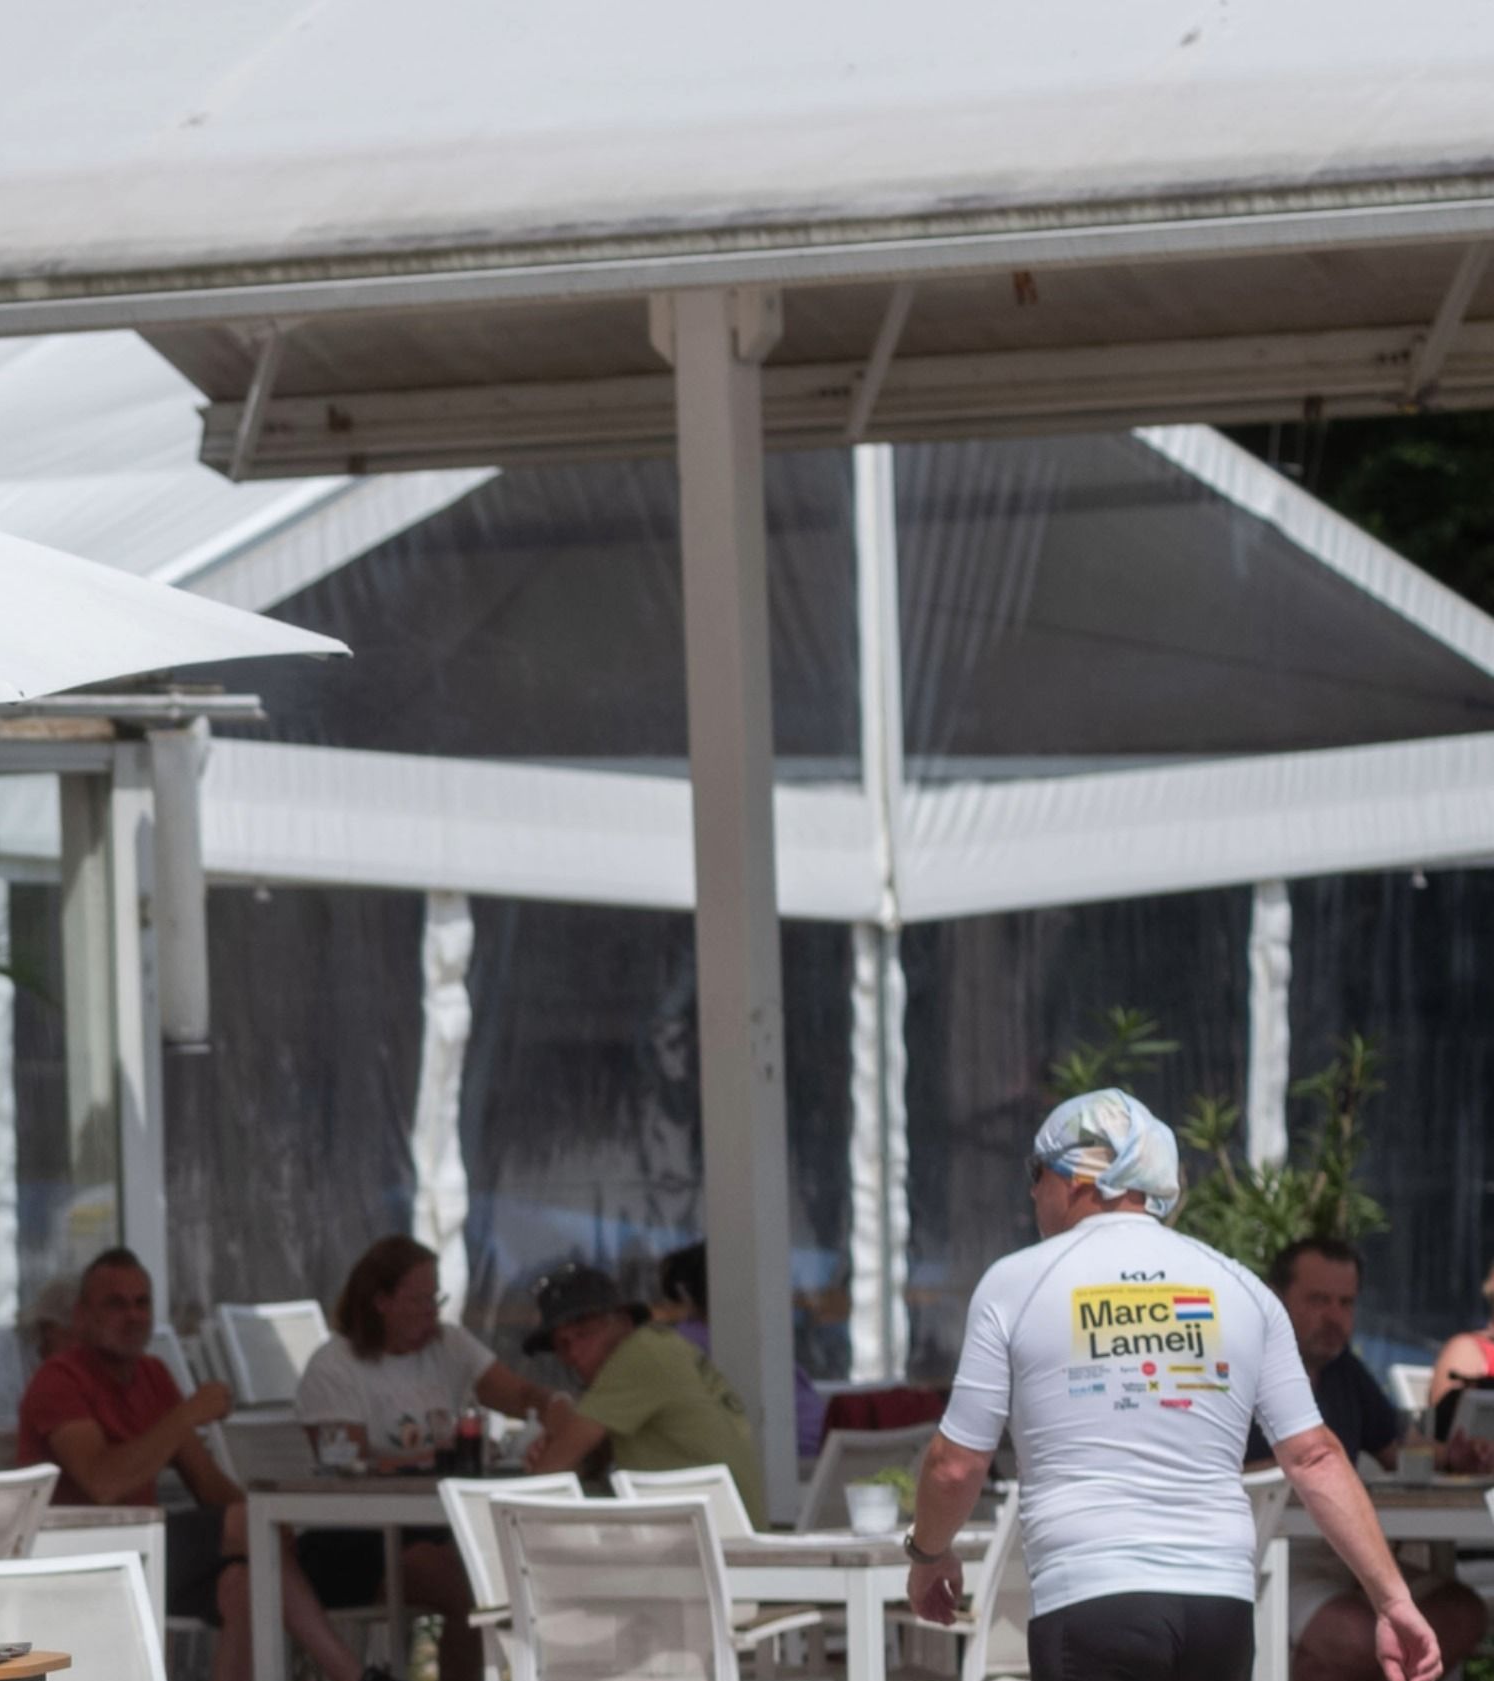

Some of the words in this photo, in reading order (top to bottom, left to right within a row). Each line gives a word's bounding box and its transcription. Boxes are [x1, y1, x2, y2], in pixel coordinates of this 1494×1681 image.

[1121, 1270, 1166, 1281] KIA
[1080, 1299, 1170, 1330] Marc
[1089, 1323, 1204, 1359] Lameij
